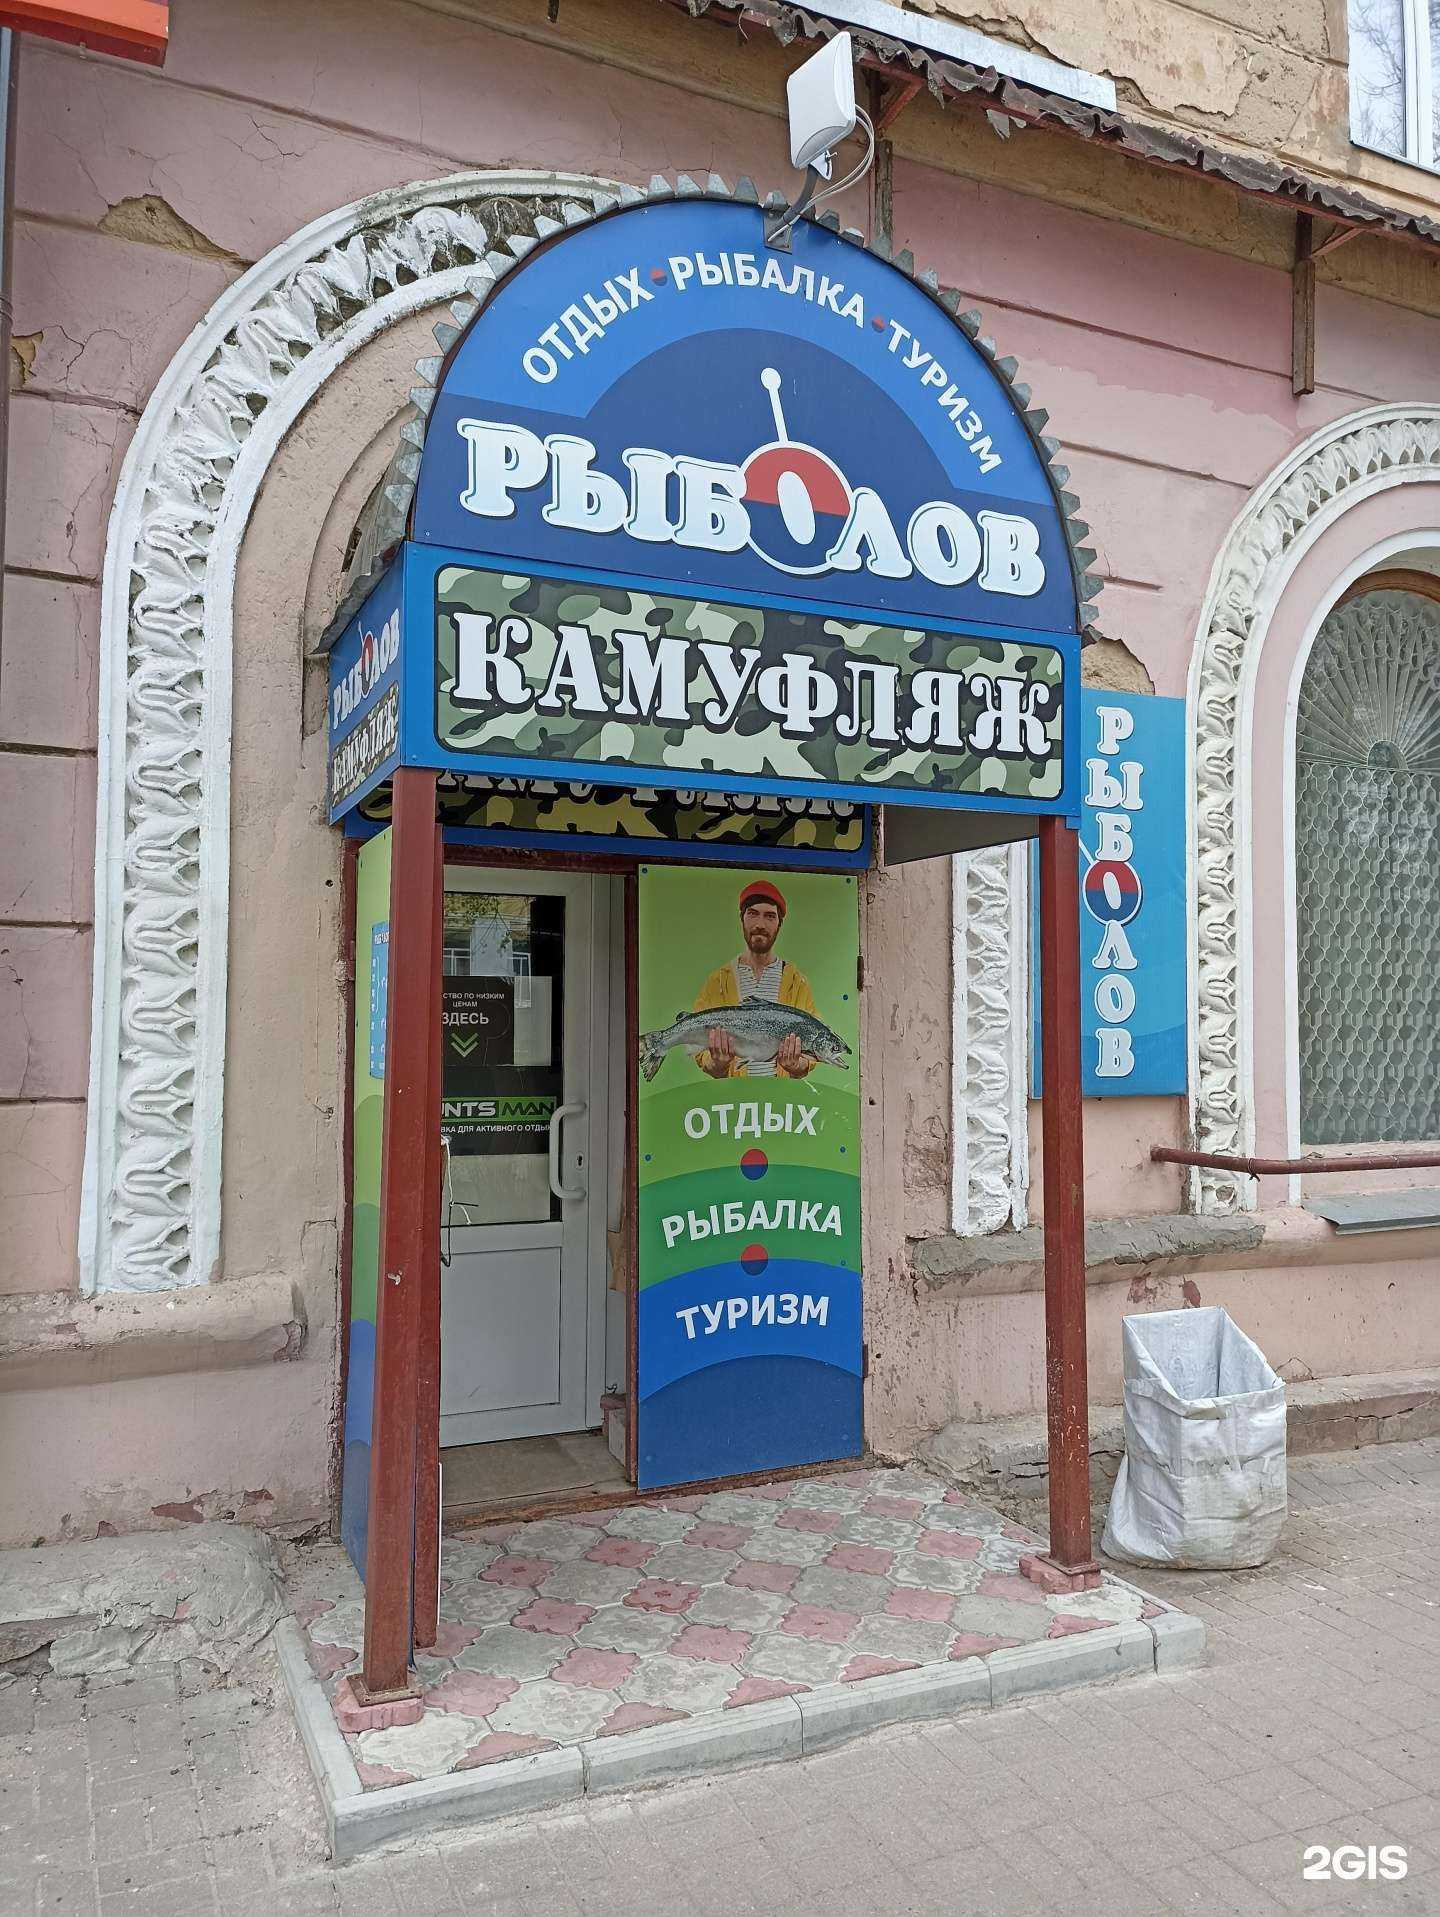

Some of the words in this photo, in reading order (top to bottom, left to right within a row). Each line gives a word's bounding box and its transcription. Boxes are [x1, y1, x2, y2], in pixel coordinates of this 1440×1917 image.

[522, 267, 656, 385] ОТДЫХ
[668, 251, 866, 329] РЫБАЛКА
[886, 319, 1003, 474] ТУРИЗМ
[456, 417, 1047, 597] РЫБОЛОВ
[332, 607, 400, 730] РЫБОЛОВ
[449, 611, 1053, 755] КАМУФЛЯЖ
[1083, 705, 1143, 1078] РЫБОЛОВ
[442, 1011, 489, 1027] ЗДЕСЬ
[476, 992, 505, 1000] НИЗКИМ
[457, 1125, 474, 1134] ДЛЯ
[476, 1124, 523, 1133] АКТИВНОГО
[524, 1124, 552, 1133] ОТДЫ
[683, 1102, 820, 1140] ОТДЫХ
[661, 1199, 843, 1249] РЫБАЛКА
[675, 1293, 830, 1340] ТУРИЗМ
